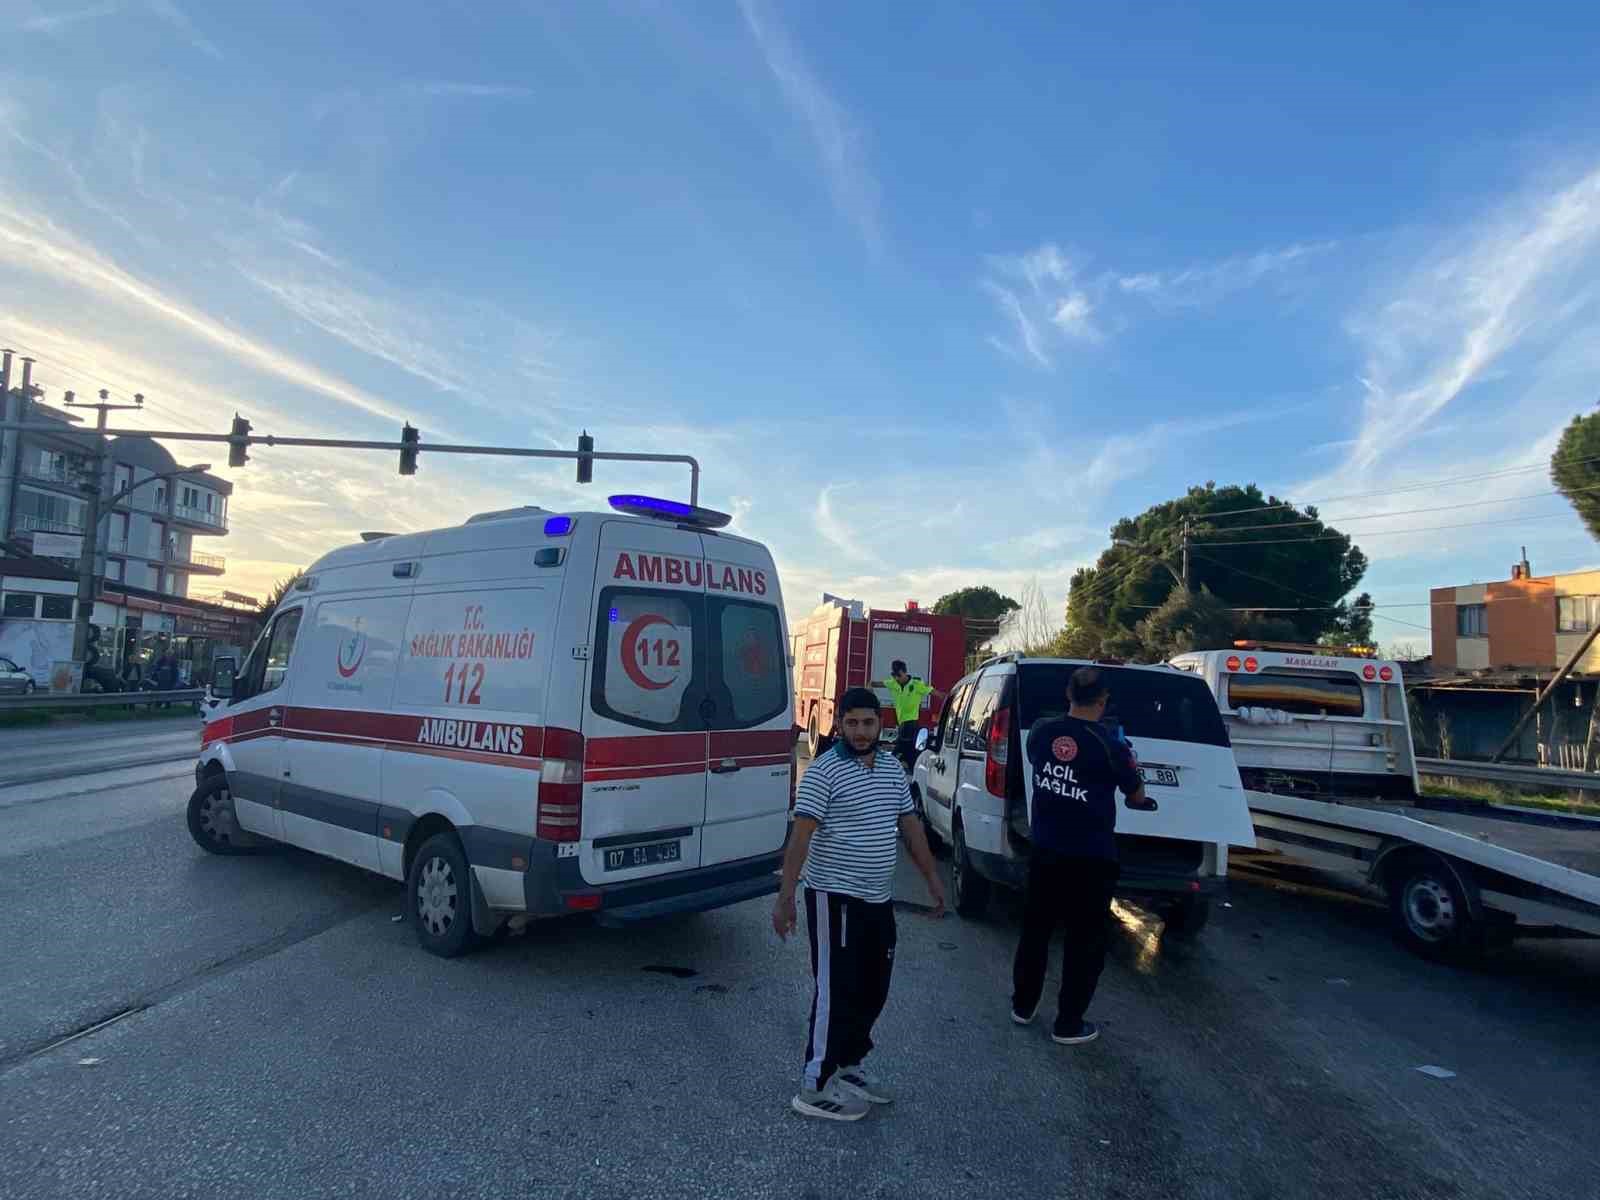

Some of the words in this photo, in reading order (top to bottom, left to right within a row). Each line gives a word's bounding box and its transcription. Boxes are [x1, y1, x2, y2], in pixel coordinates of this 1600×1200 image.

[613, 552, 767, 596] AMBULANS
[464, 605, 485, 630] T.C.
[410, 630, 455, 657] SAĞLIK
[457, 628, 536, 659] BAKANLIĞI
[638, 639, 680, 666] 112
[444, 663, 485, 704] 112
[418, 718, 524, 755] AMBULANS
[1042, 762, 1078, 785] ACİL
[609, 850, 625, 867] 07
